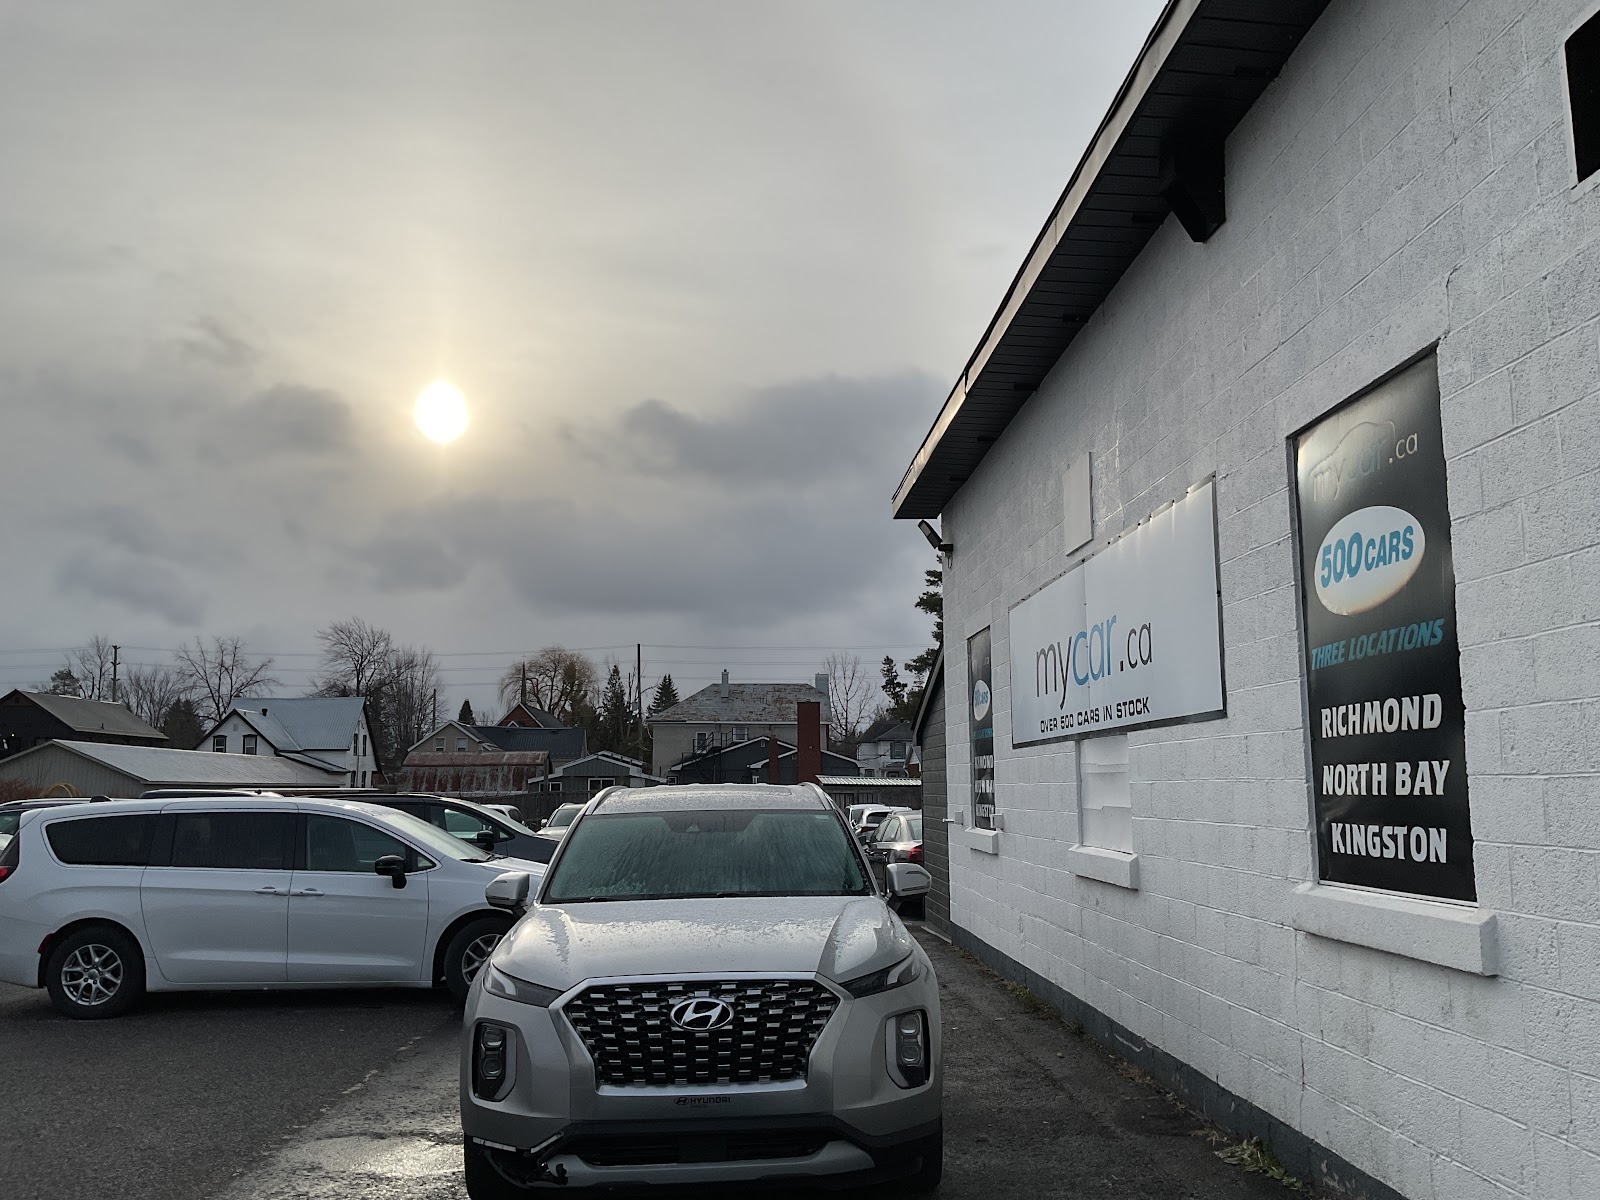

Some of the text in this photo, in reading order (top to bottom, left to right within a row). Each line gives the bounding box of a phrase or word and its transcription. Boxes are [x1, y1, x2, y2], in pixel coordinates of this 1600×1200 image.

[1311, 618, 1445, 670] THREE LOCATIONS
[1040, 696, 1151, 733] OVER 500 CARS IN STOCK
[1320, 693, 1442, 738] RICHMOND
[1322, 759, 1450, 796] NORTH BAY
[1330, 822, 1447, 864] KINGSTON
[690, 1096, 731, 1104] HYUNDAI
